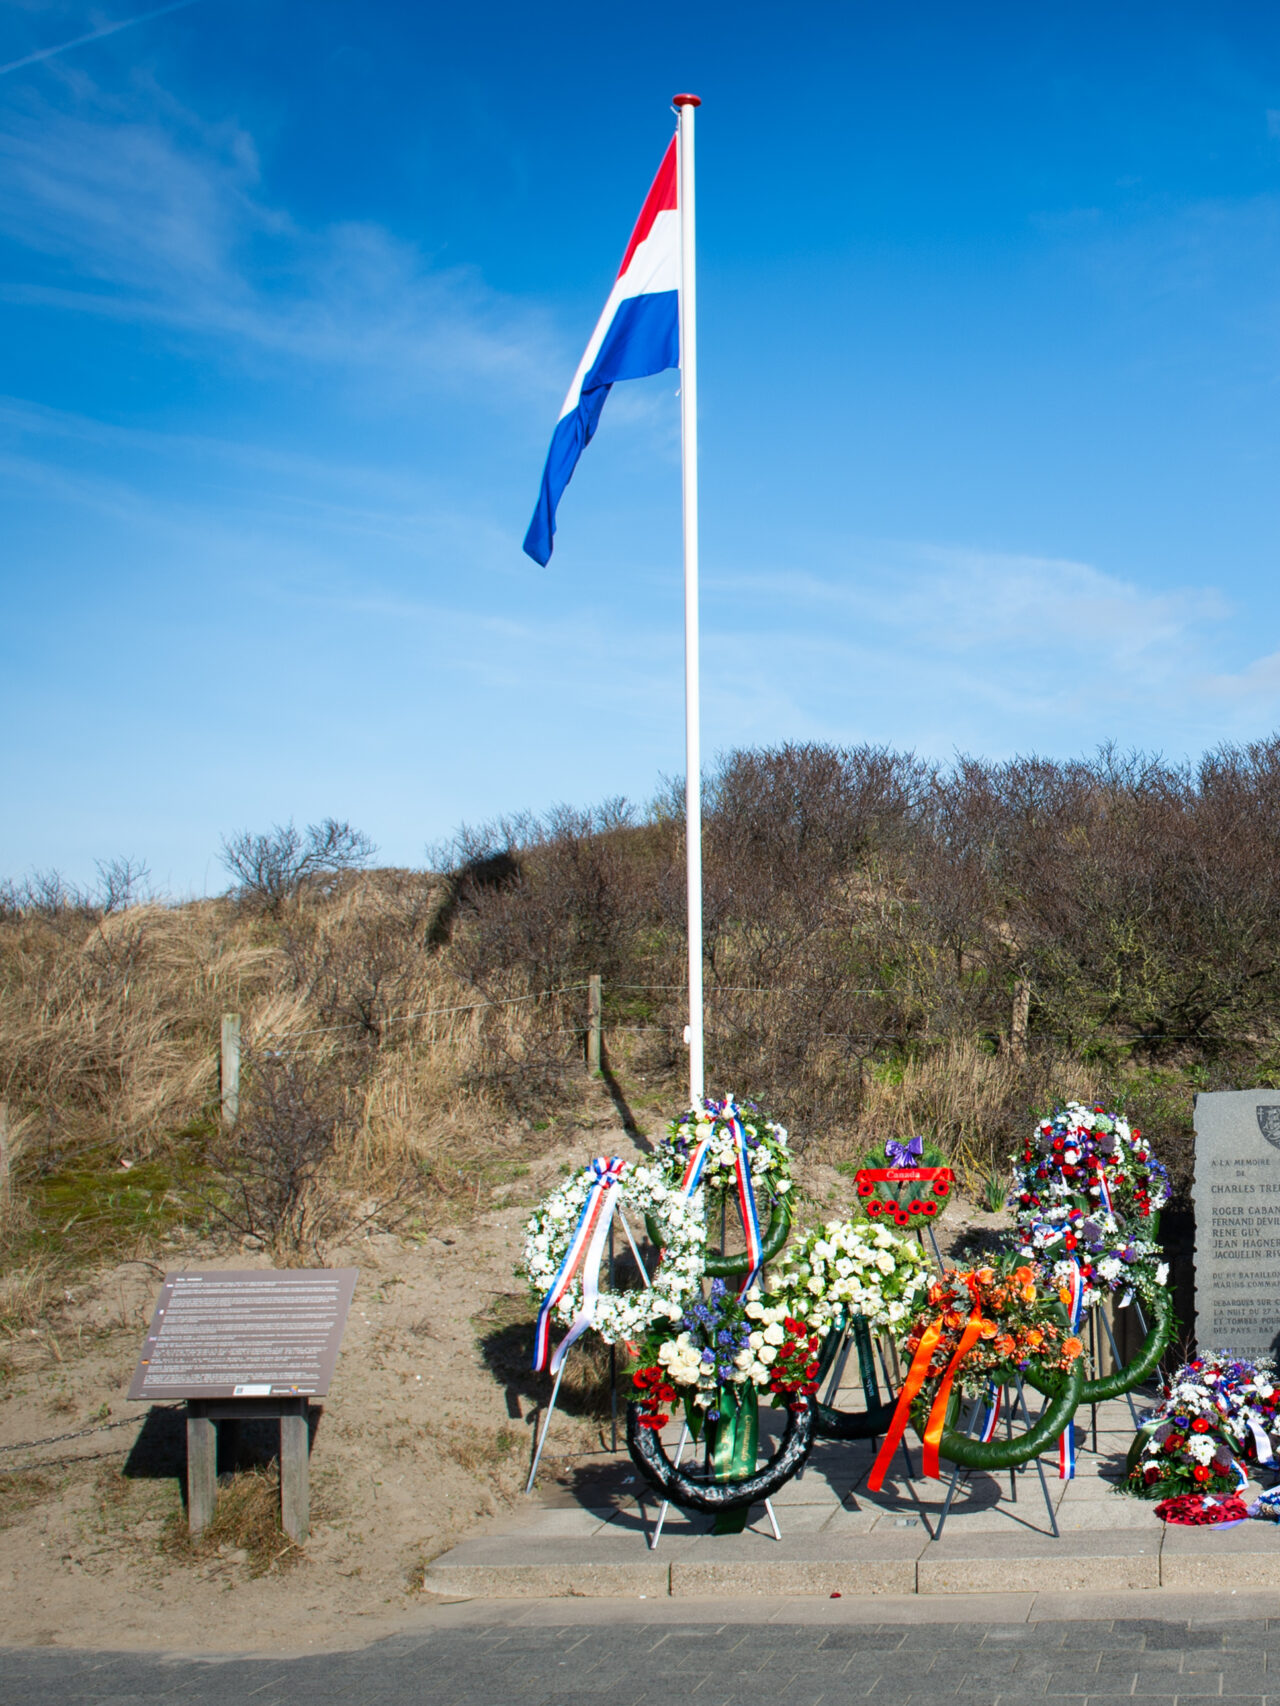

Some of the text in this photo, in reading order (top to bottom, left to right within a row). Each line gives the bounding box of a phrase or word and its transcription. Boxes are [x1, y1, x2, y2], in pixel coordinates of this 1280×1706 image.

[886, 1171, 921, 1179] Canada
[1211, 1184, 1256, 1193] CHARLES
[1212, 1206, 1244, 1216] ROGER
[1212, 1217, 1254, 1226] FERNAND
[1241, 1228, 1262, 1237] GUY
[1212, 1239, 1239, 1248] JEAN
[1212, 1250, 1261, 1259] JACQUELIN
